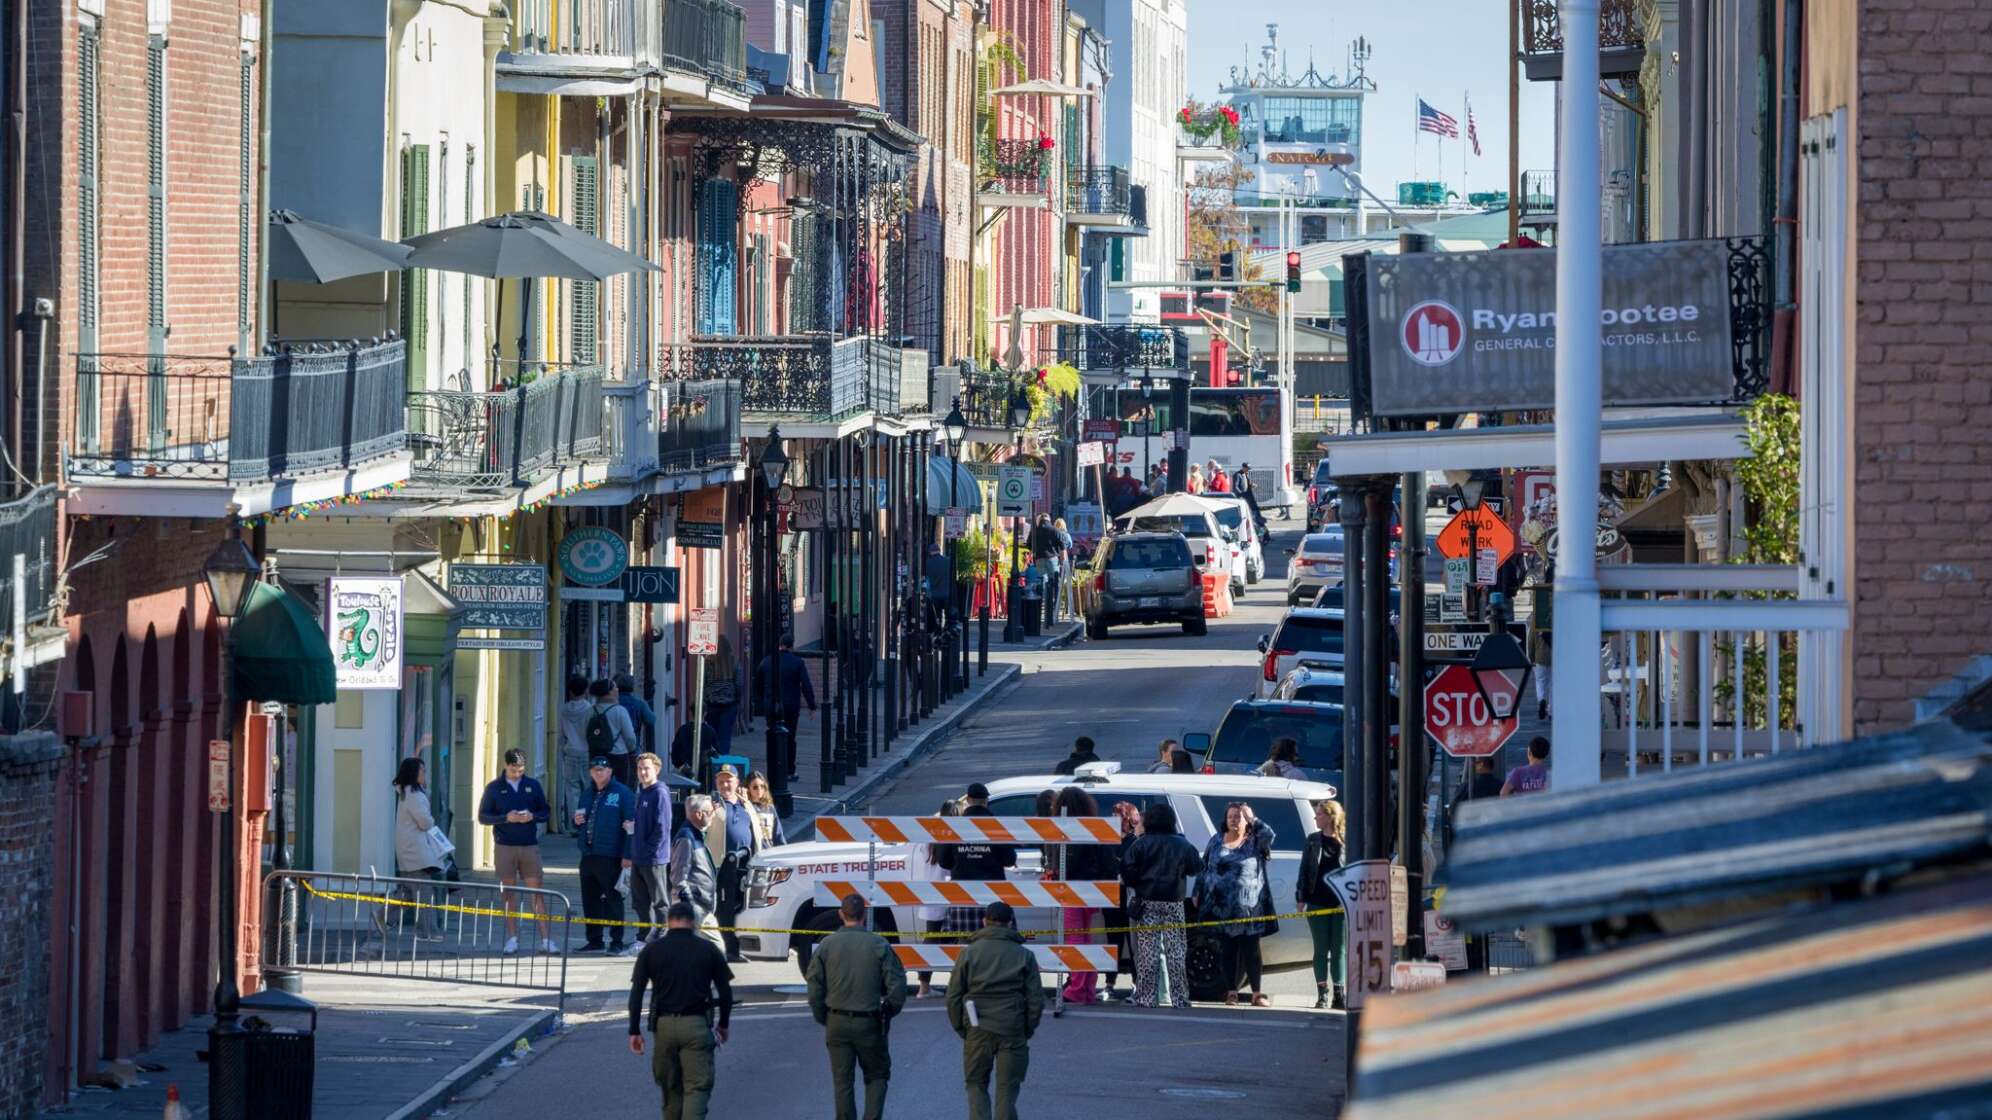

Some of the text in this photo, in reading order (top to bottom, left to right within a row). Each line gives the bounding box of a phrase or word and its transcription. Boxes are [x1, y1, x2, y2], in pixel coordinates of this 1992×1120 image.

[1473, 304, 1699, 334] Ryan ootee
[1474, 330, 1702, 352] GENERAL CCTORS, L.L.C.
[1461, 519, 1493, 531] RAD
[1461, 536, 1493, 548] WRK
[451, 586, 487, 601] ROUX
[488, 586, 545, 602] ROYALE
[1427, 634, 1457, 649] ONE
[1431, 692, 1513, 727] STOP
[798, 863, 839, 874] STATE
[1345, 880, 1387, 902] SPEED
[1356, 910, 1384, 932] LIMIT
[1357, 940, 1383, 993] 15
